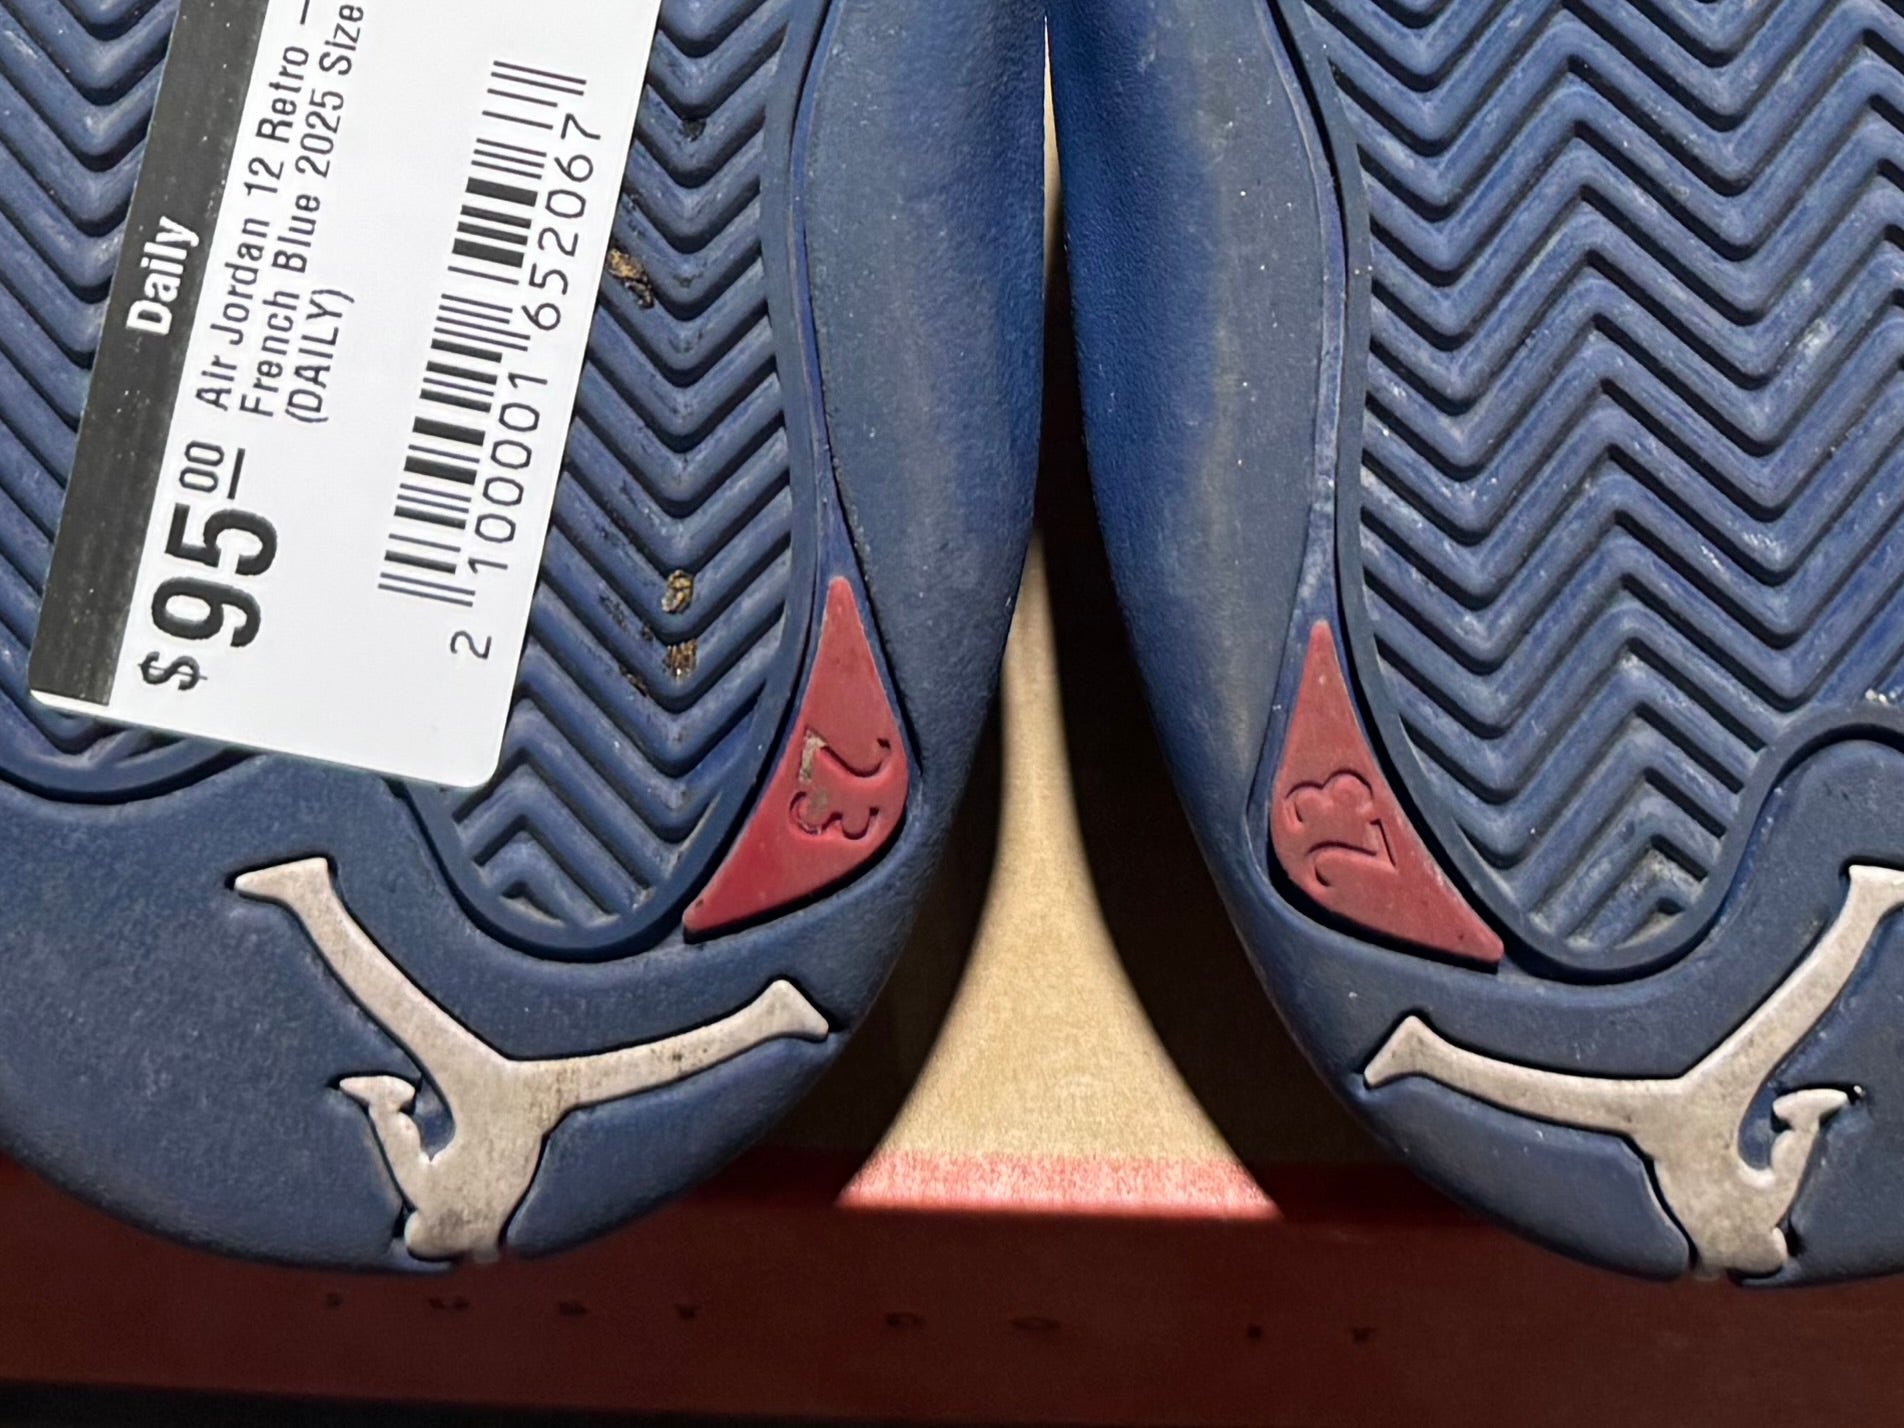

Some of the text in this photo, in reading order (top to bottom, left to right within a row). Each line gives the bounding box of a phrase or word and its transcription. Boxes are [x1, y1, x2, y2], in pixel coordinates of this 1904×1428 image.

[318, 4, 364, 76] Size
[255, 46, 309, 143] Retro
[295, 89, 344, 178] 2025
[244, 157, 284, 196] 12
[125, 215, 200, 335] Daily
[210, 218, 269, 346] Jordan
[271, 194, 320, 273] Blue
[195, 355, 237, 411] Air
[239, 291, 300, 417] French
[285, 288, 355, 424] (DAILY)
[786, 726, 893, 840] 23
[1284, 768, 1397, 887] 23
